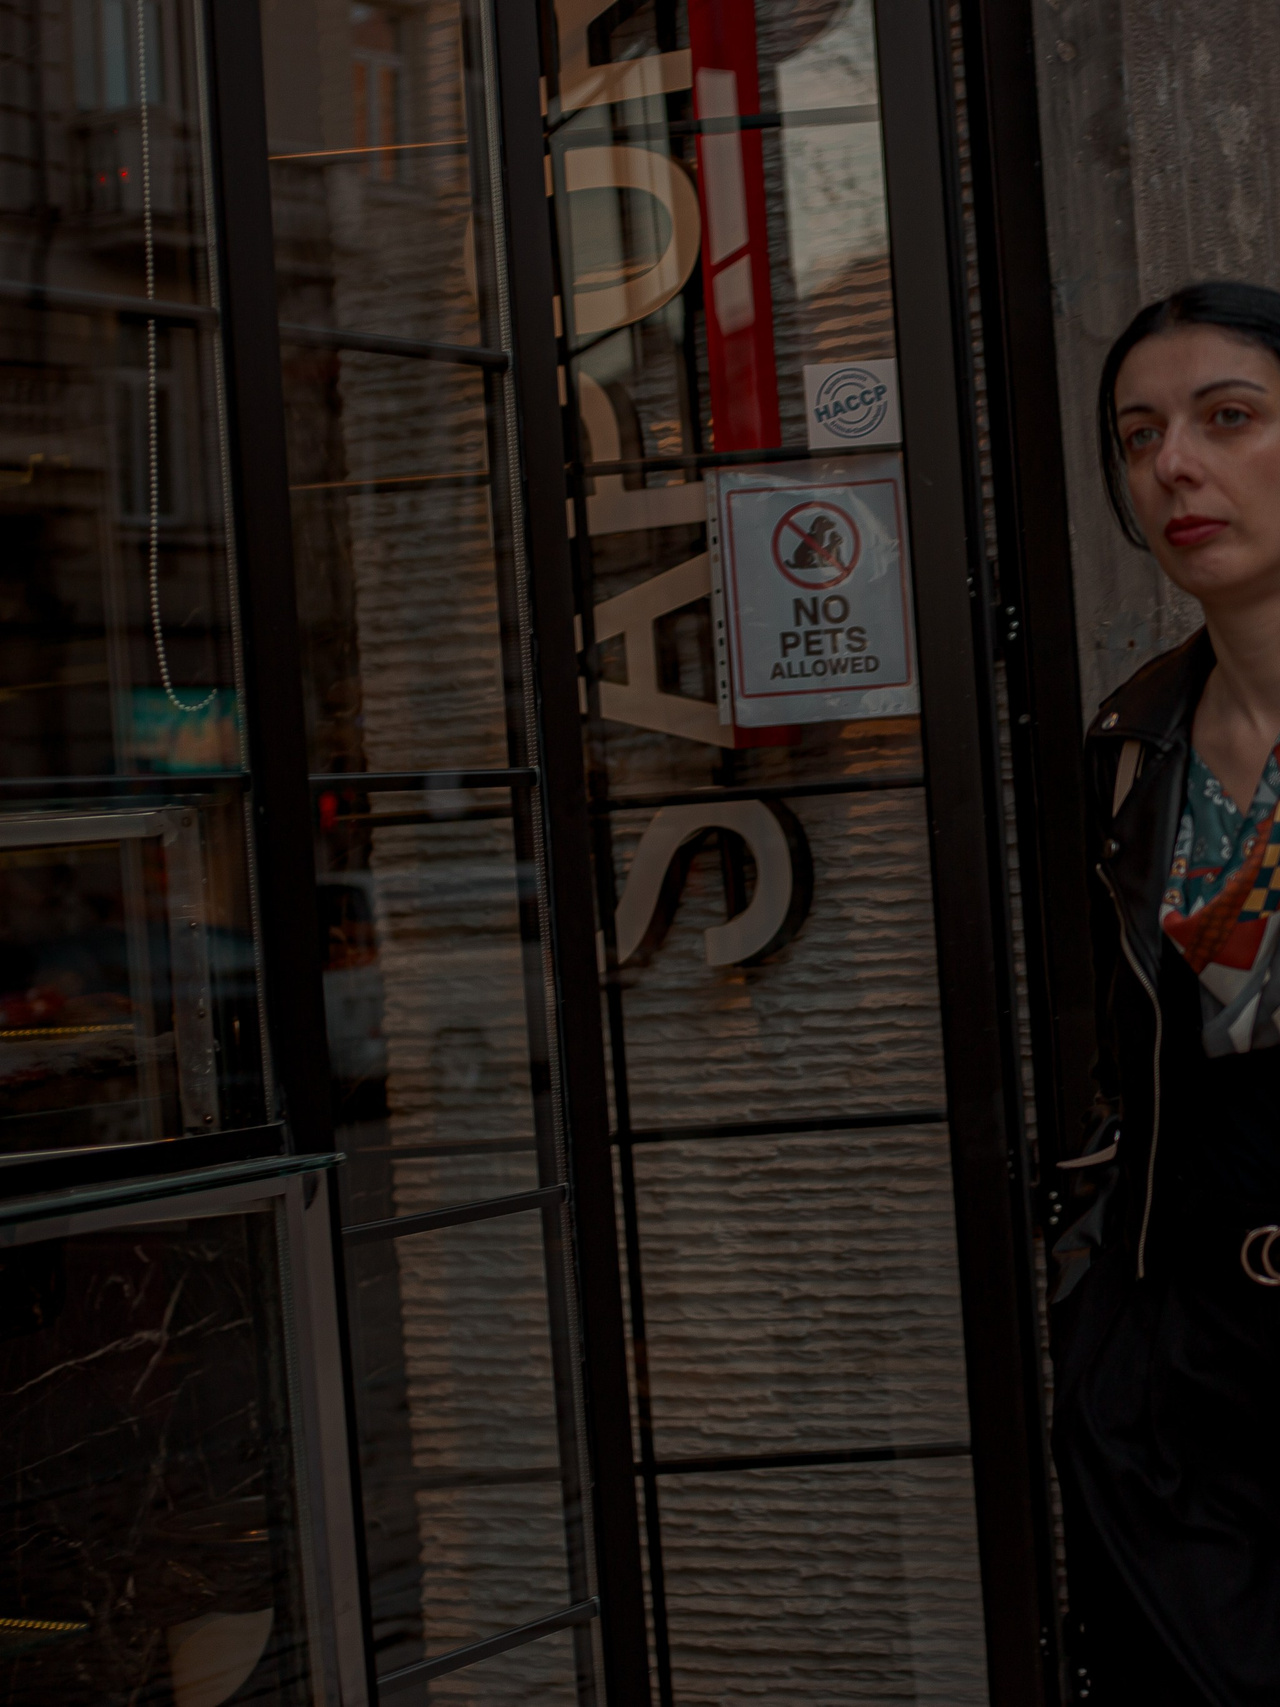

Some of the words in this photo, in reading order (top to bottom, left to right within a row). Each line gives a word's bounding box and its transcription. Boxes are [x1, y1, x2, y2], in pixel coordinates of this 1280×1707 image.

[813, 384, 888, 423] HACCP
[793, 594, 850, 627] NO
[780, 626, 868, 658] PETS
[770, 655, 880, 680] ALLOWED
